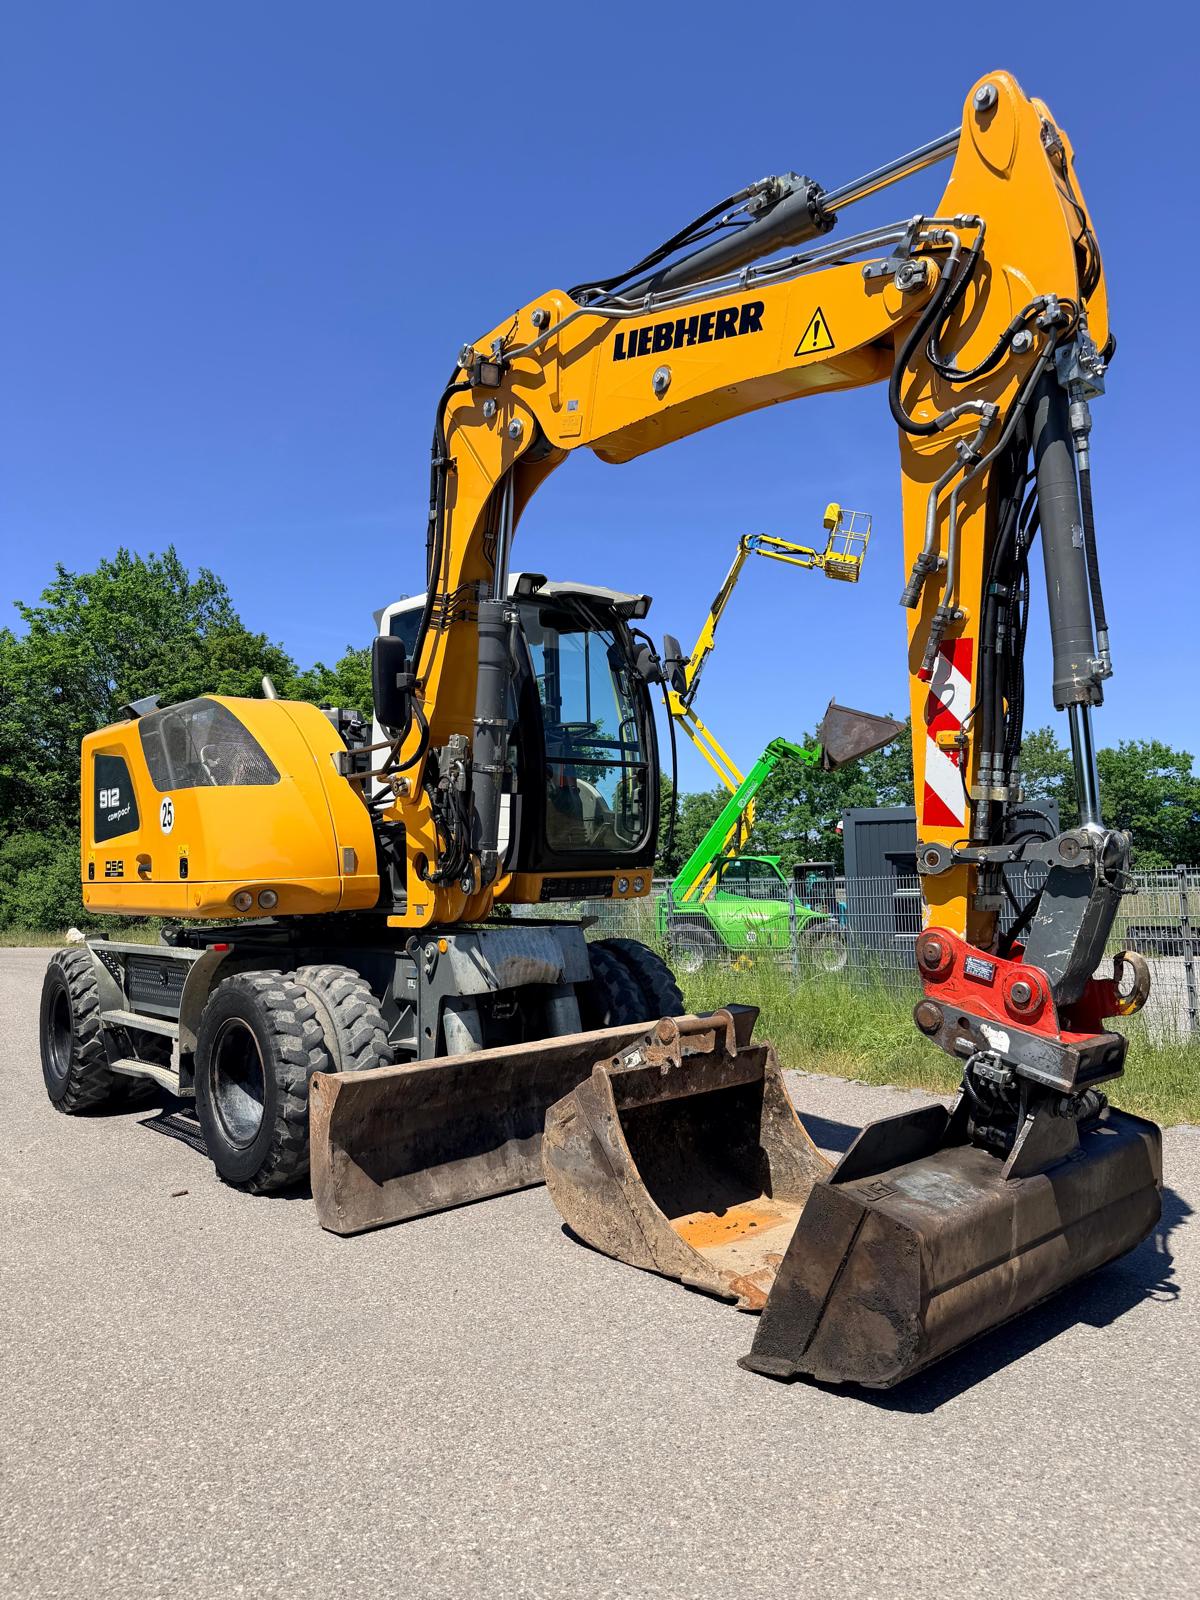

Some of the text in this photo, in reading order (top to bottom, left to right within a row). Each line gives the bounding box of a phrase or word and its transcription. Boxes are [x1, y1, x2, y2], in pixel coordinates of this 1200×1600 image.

[612, 300, 765, 362] LIEBHERR
[99, 788, 120, 809] 912
[107, 802, 131, 822] compact
[162, 802, 173, 828] 25
